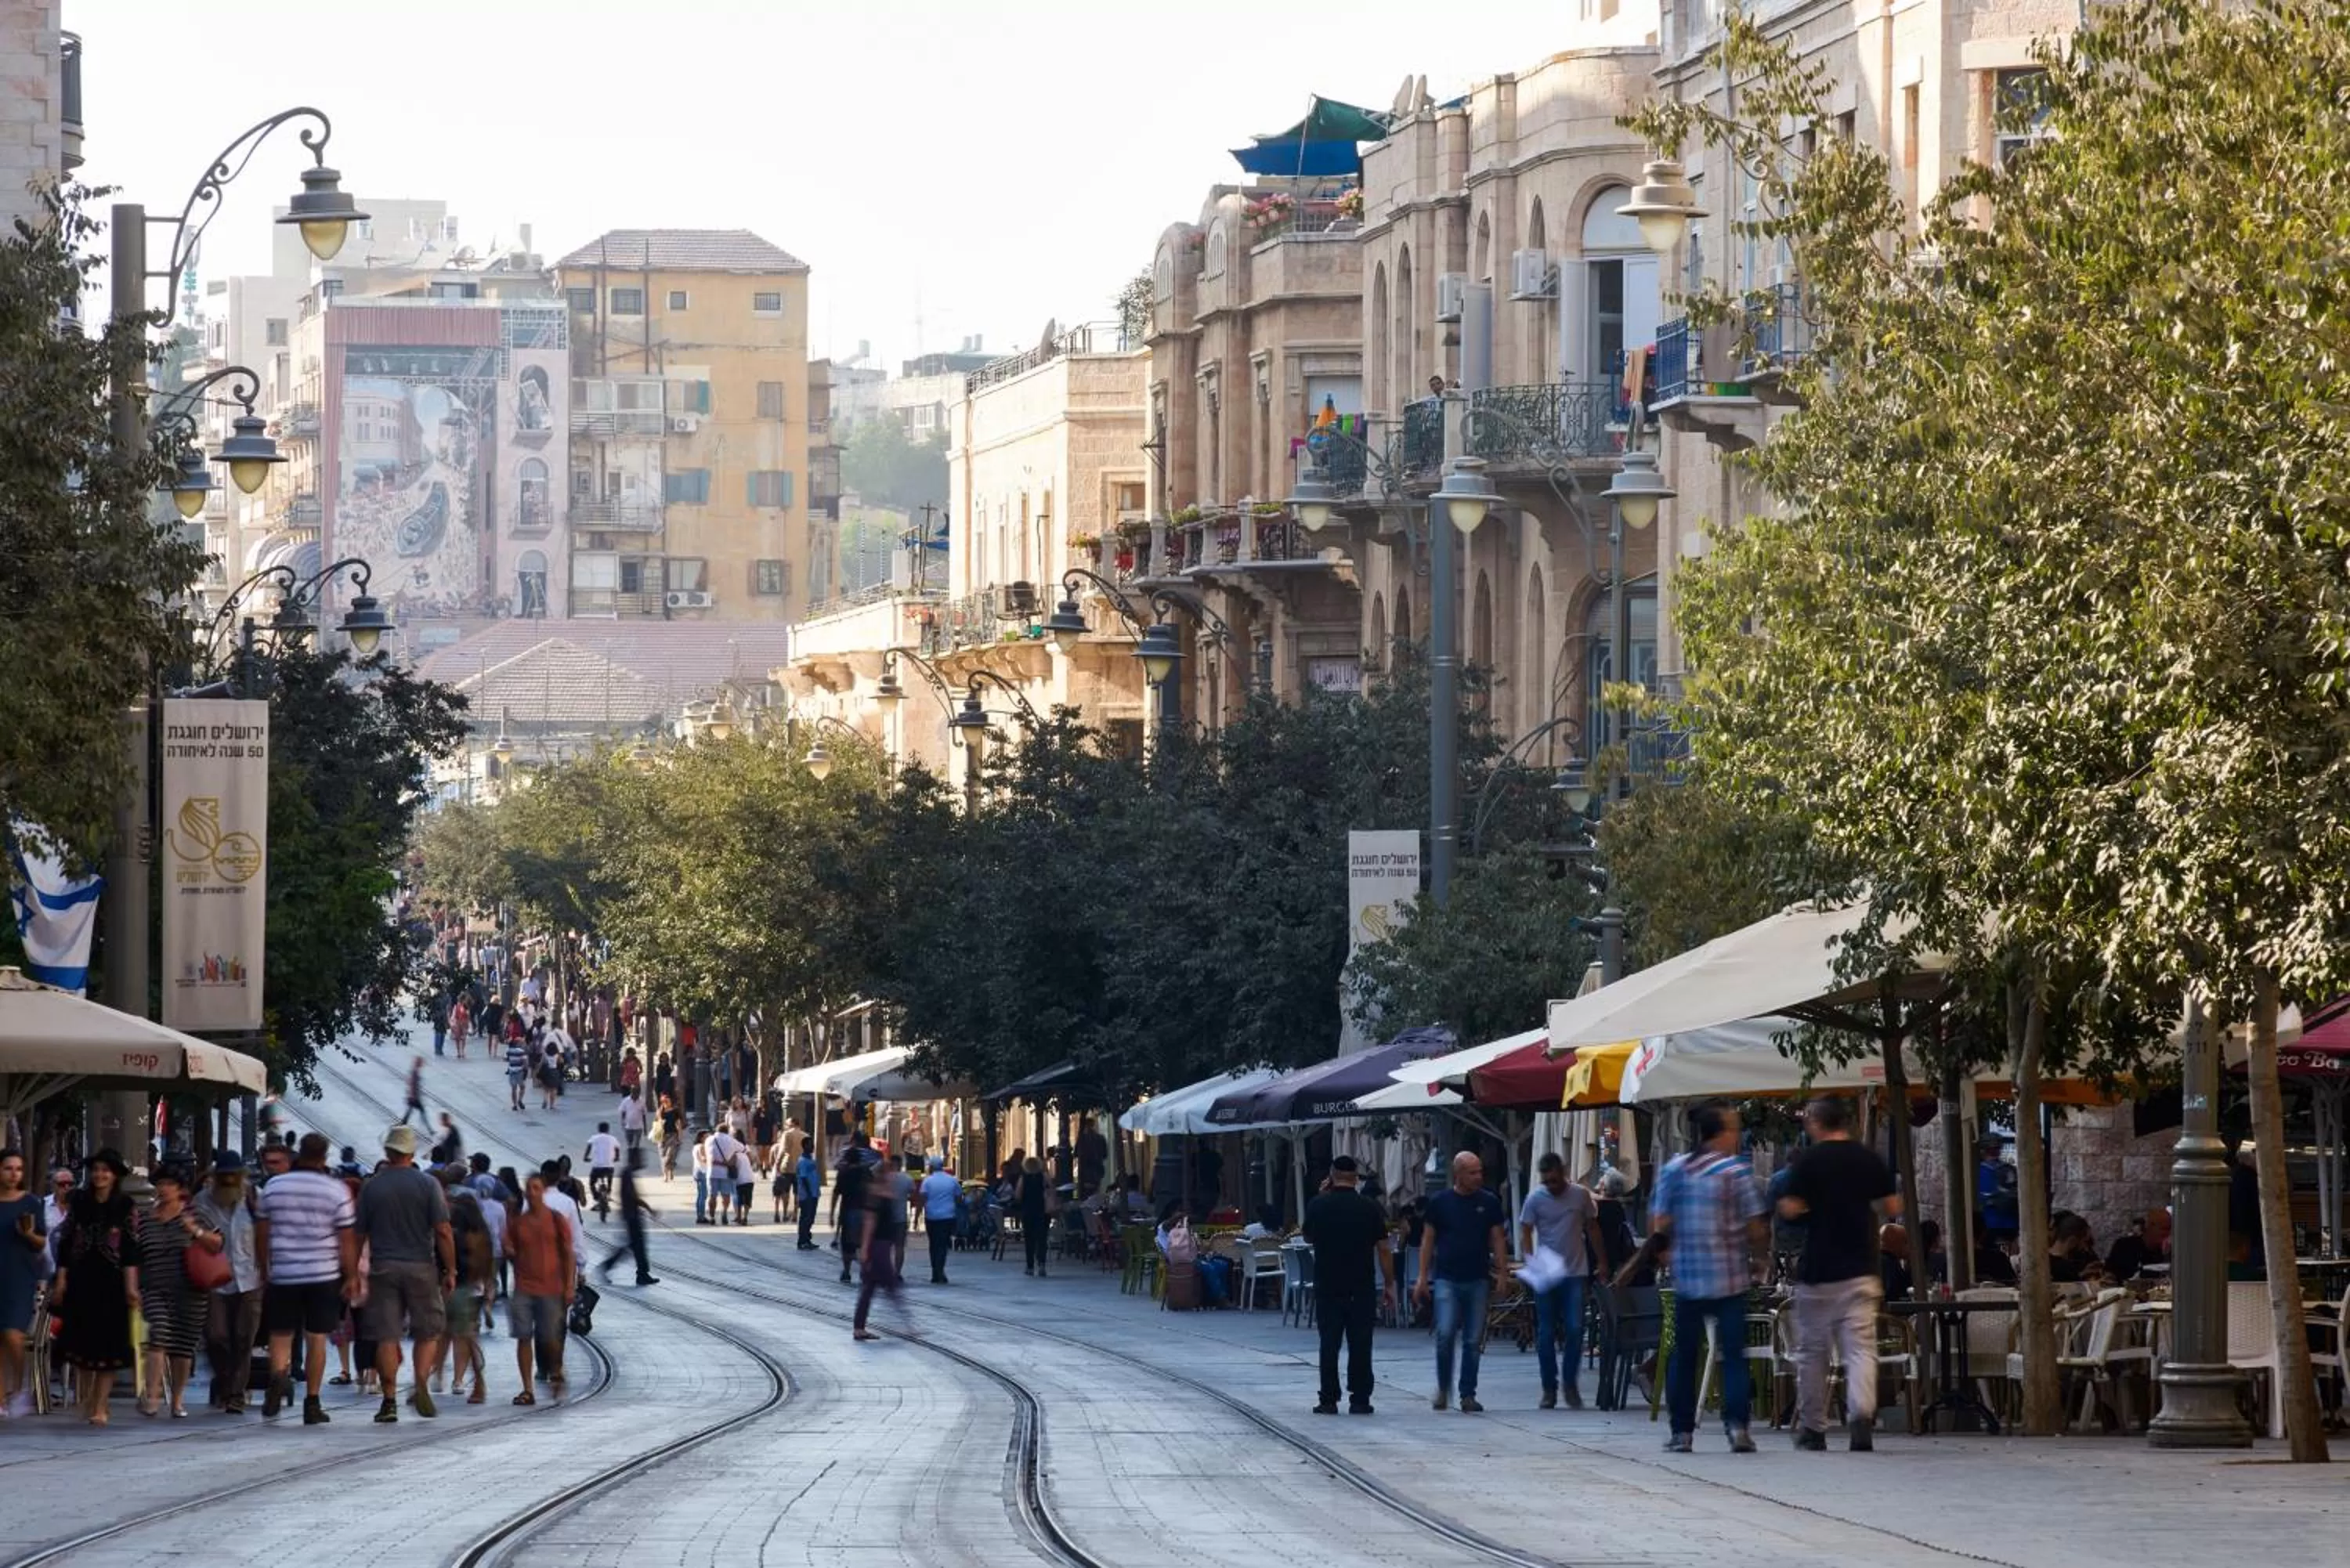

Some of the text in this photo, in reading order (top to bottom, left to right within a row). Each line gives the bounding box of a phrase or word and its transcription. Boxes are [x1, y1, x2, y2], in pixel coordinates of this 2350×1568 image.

[167, 722, 264, 740] ירושלים חוגגת
[167, 742, 264, 758] 50 שנה לאיחודה
[1351, 851, 1418, 865] ירושלים חוגגת
[1386, 868, 1405, 878] שנה
